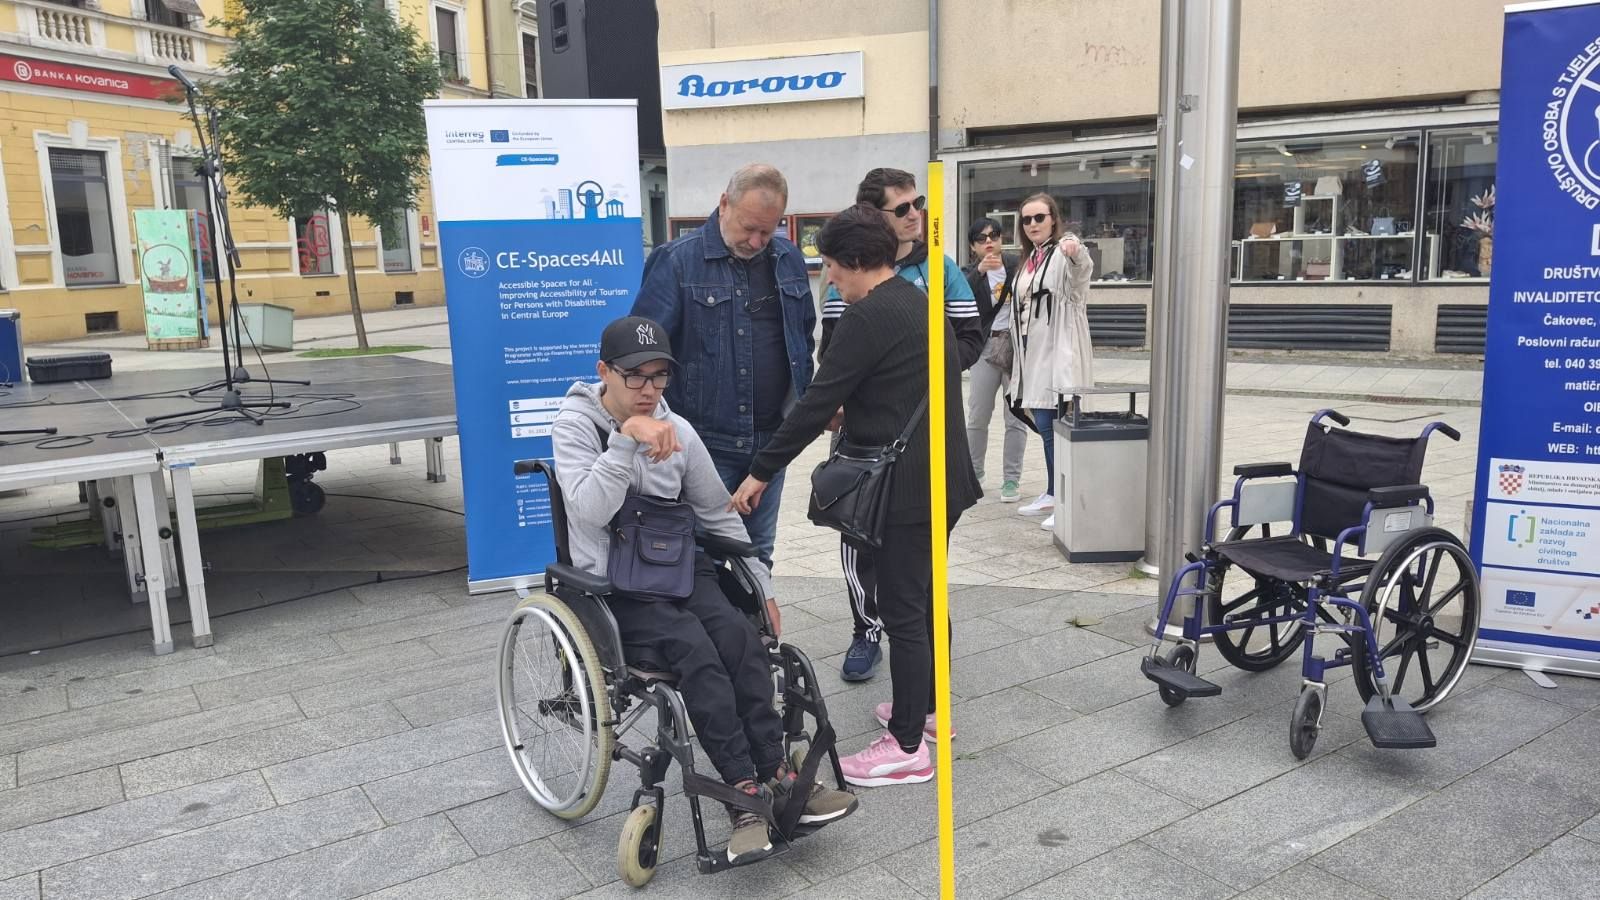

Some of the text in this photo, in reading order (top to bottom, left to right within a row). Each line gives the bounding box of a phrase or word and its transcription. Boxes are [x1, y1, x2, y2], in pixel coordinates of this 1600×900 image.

[34, 68, 73, 81] BANKA
[1552, 86, 1567, 98] S
[1543, 99, 1562, 151] OSOBA
[1547, 153, 1600, 210] DRUŠTVO
[496, 249, 625, 272] CE-Spaces4All
[499, 281, 540, 290] Accessible
[540, 280, 567, 289] Spaces
[569, 279, 580, 287] for
[582, 279, 593, 287] All
[500, 288, 629, 300] Improving Accessibility of Tourism
[500, 298, 606, 310] for Persons with Disabilities
[502, 310, 569, 320] in Central Europe
[1543, 312, 1597, 327] Čakovec,
[1517, 335, 1567, 347] Poslovni
[1544, 358, 1562, 369] tel.
[1565, 358, 1585, 369] 040
[1552, 422, 1592, 434] E-mail:
[1547, 443, 1579, 454] WEB:
[1541, 517, 1591, 528] Nacionalna
[1540, 528, 1574, 537] zaklada
[1539, 538, 1566, 547] razvoj
[1538, 548, 1577, 557] civilnoga
[1537, 558, 1570, 566] društva
